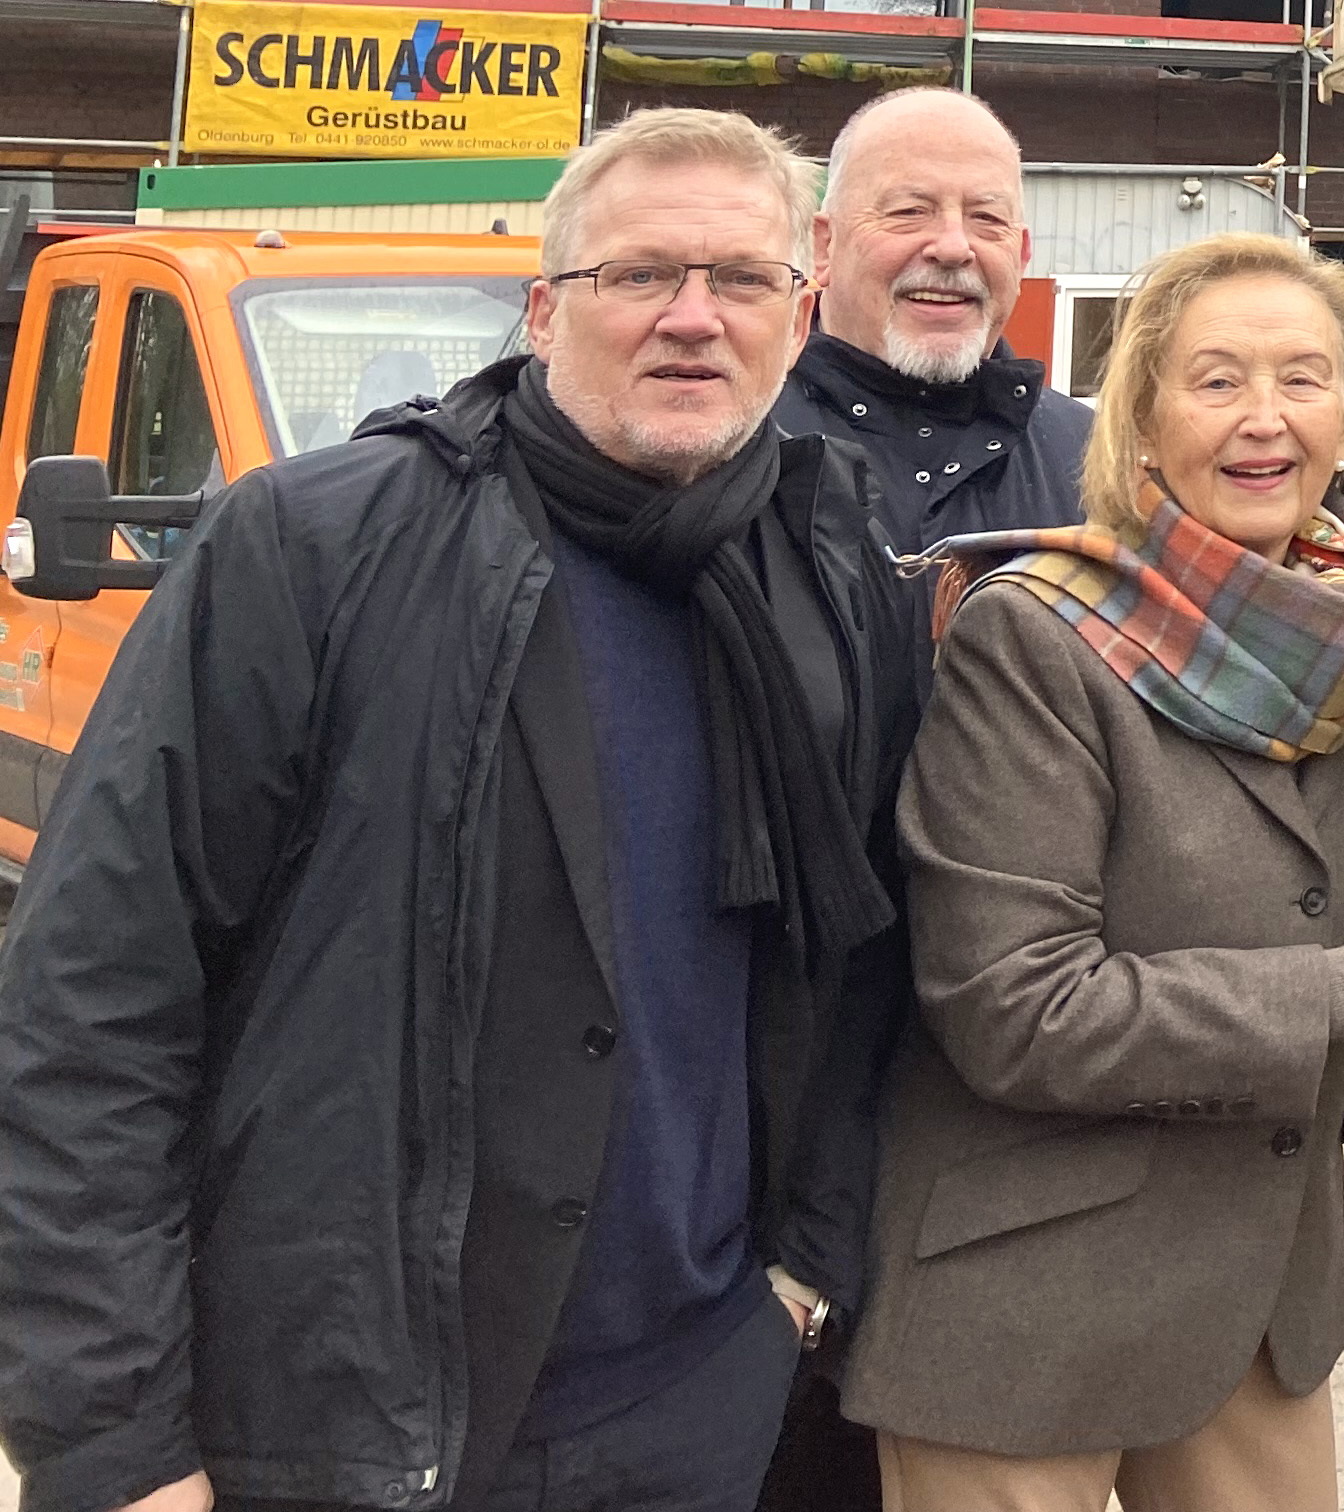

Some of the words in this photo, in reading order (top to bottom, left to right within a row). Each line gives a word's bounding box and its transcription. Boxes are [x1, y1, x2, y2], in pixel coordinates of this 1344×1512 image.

[214, 32, 561, 97] SCHMACKER
[306, 105, 467, 131] Gerüstbau
[197, 129, 274, 144] Oldenburg
